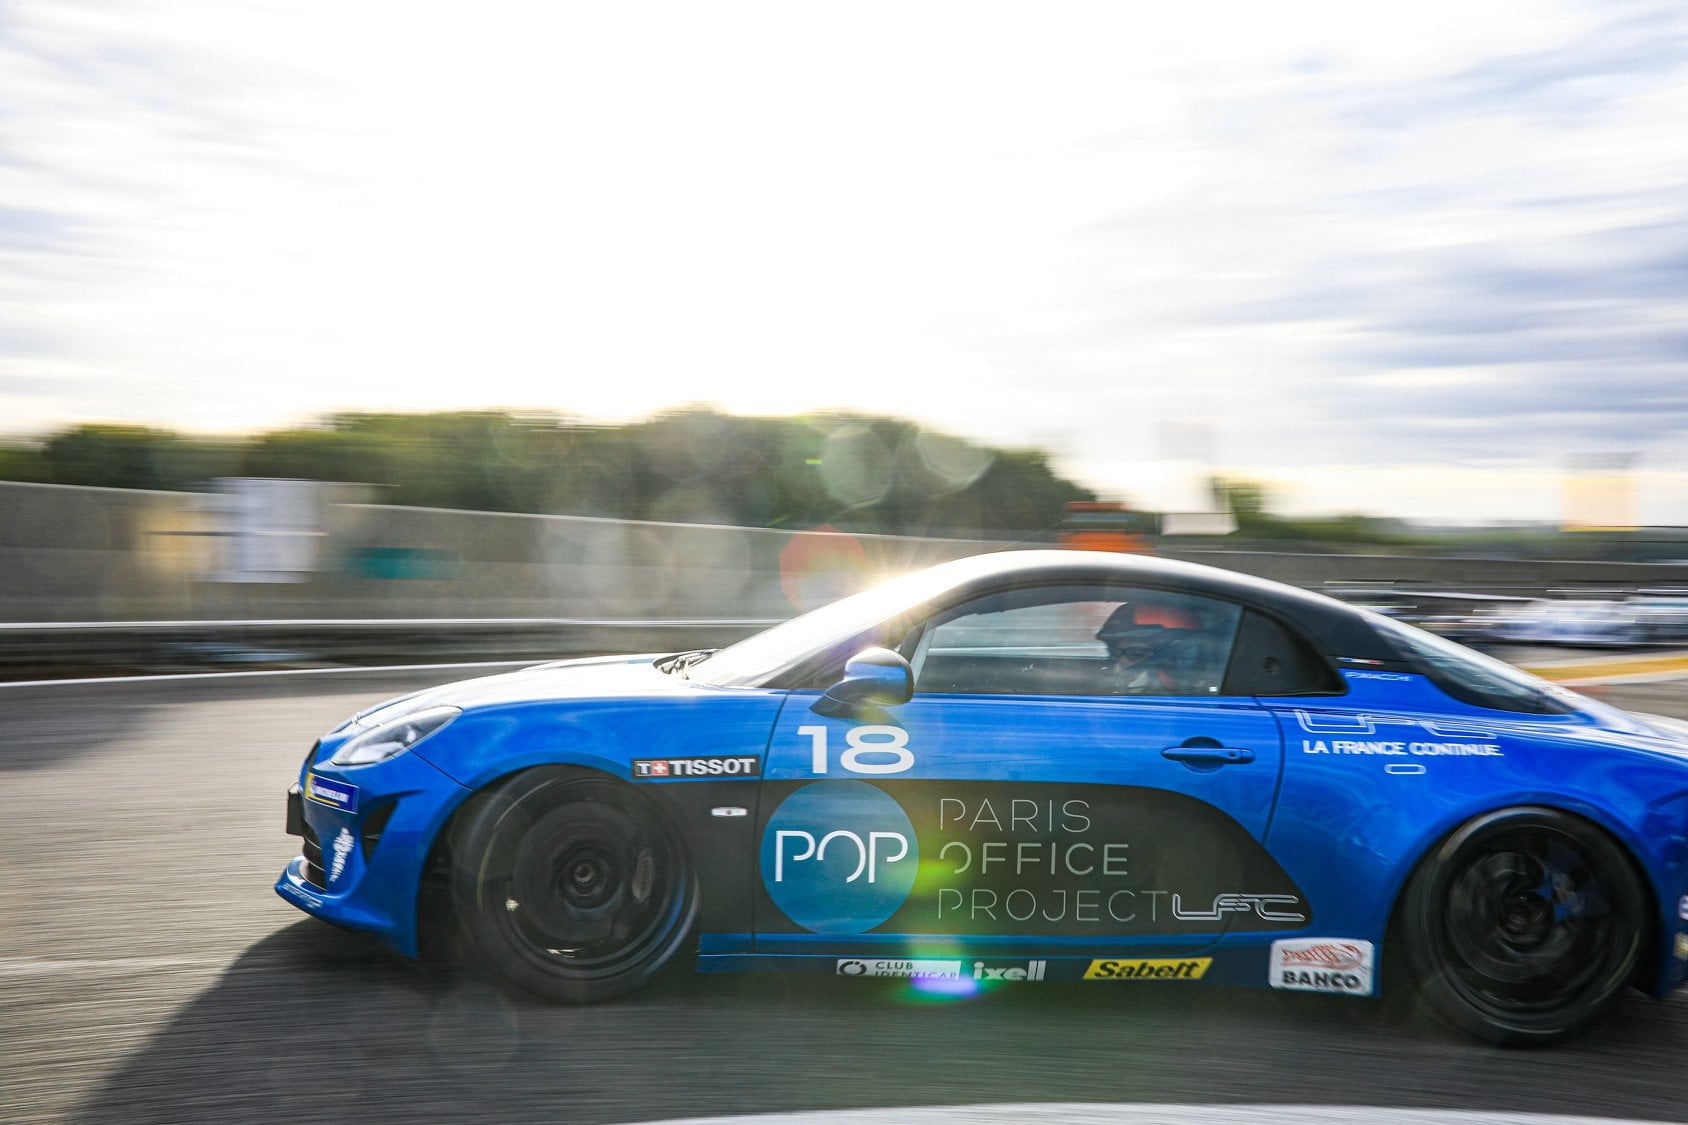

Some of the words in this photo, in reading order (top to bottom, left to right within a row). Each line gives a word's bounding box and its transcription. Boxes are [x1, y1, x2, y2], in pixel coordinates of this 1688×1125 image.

[797, 725, 915, 774] 18
[1302, 739, 1329, 754] LA
[1331, 740, 1409, 756] FRANCE
[668, 758, 756, 775] TISSOT
[939, 798, 1091, 833] PARIS
[775, 830, 908, 884] POP
[939, 841, 1129, 876] OFFICE
[938, 888, 1168, 922] PROJECT
[1172, 893, 1306, 922] LFC
[875, 961, 914, 970] CLUB
[973, 960, 1047, 981] ixell
[1094, 961, 1200, 978] Sabelt
